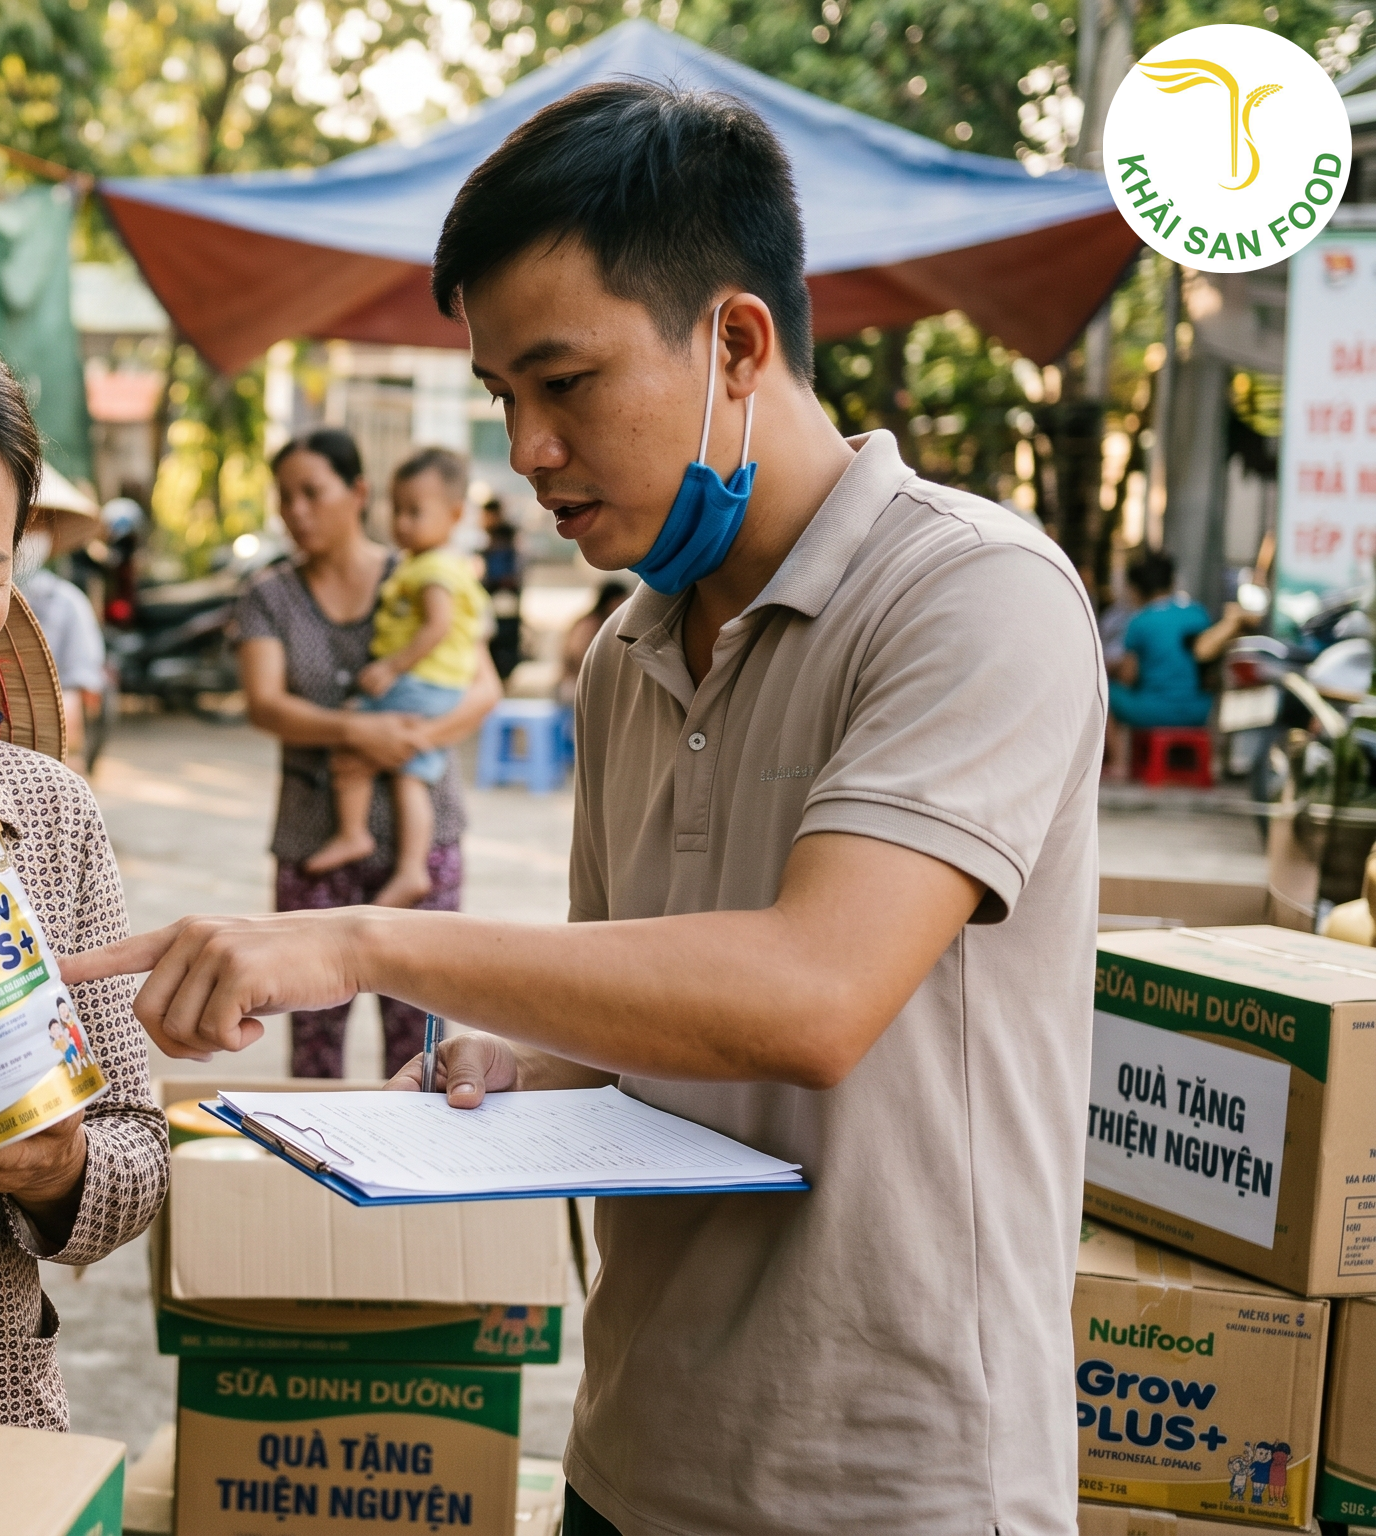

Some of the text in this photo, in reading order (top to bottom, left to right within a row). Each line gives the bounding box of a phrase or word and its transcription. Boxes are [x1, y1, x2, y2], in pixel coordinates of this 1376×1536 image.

[1094, 964, 1296, 1042] SỮA DINH DƯỠNG
[1118, 1062, 1246, 1133] QUÀ TẶNG
[1088, 1103, 1274, 1197] THIỆN NGUYỆN
[1089, 1317, 1215, 1357] Nutifood
[216, 1367, 485, 1410] SỮA DINH DƯỠNG
[1076, 1359, 1217, 1411] Grow
[258, 1429, 433, 1480] QUÀ TẶNG
[215, 1475, 472, 1532] THIỆN NGUYỆN
